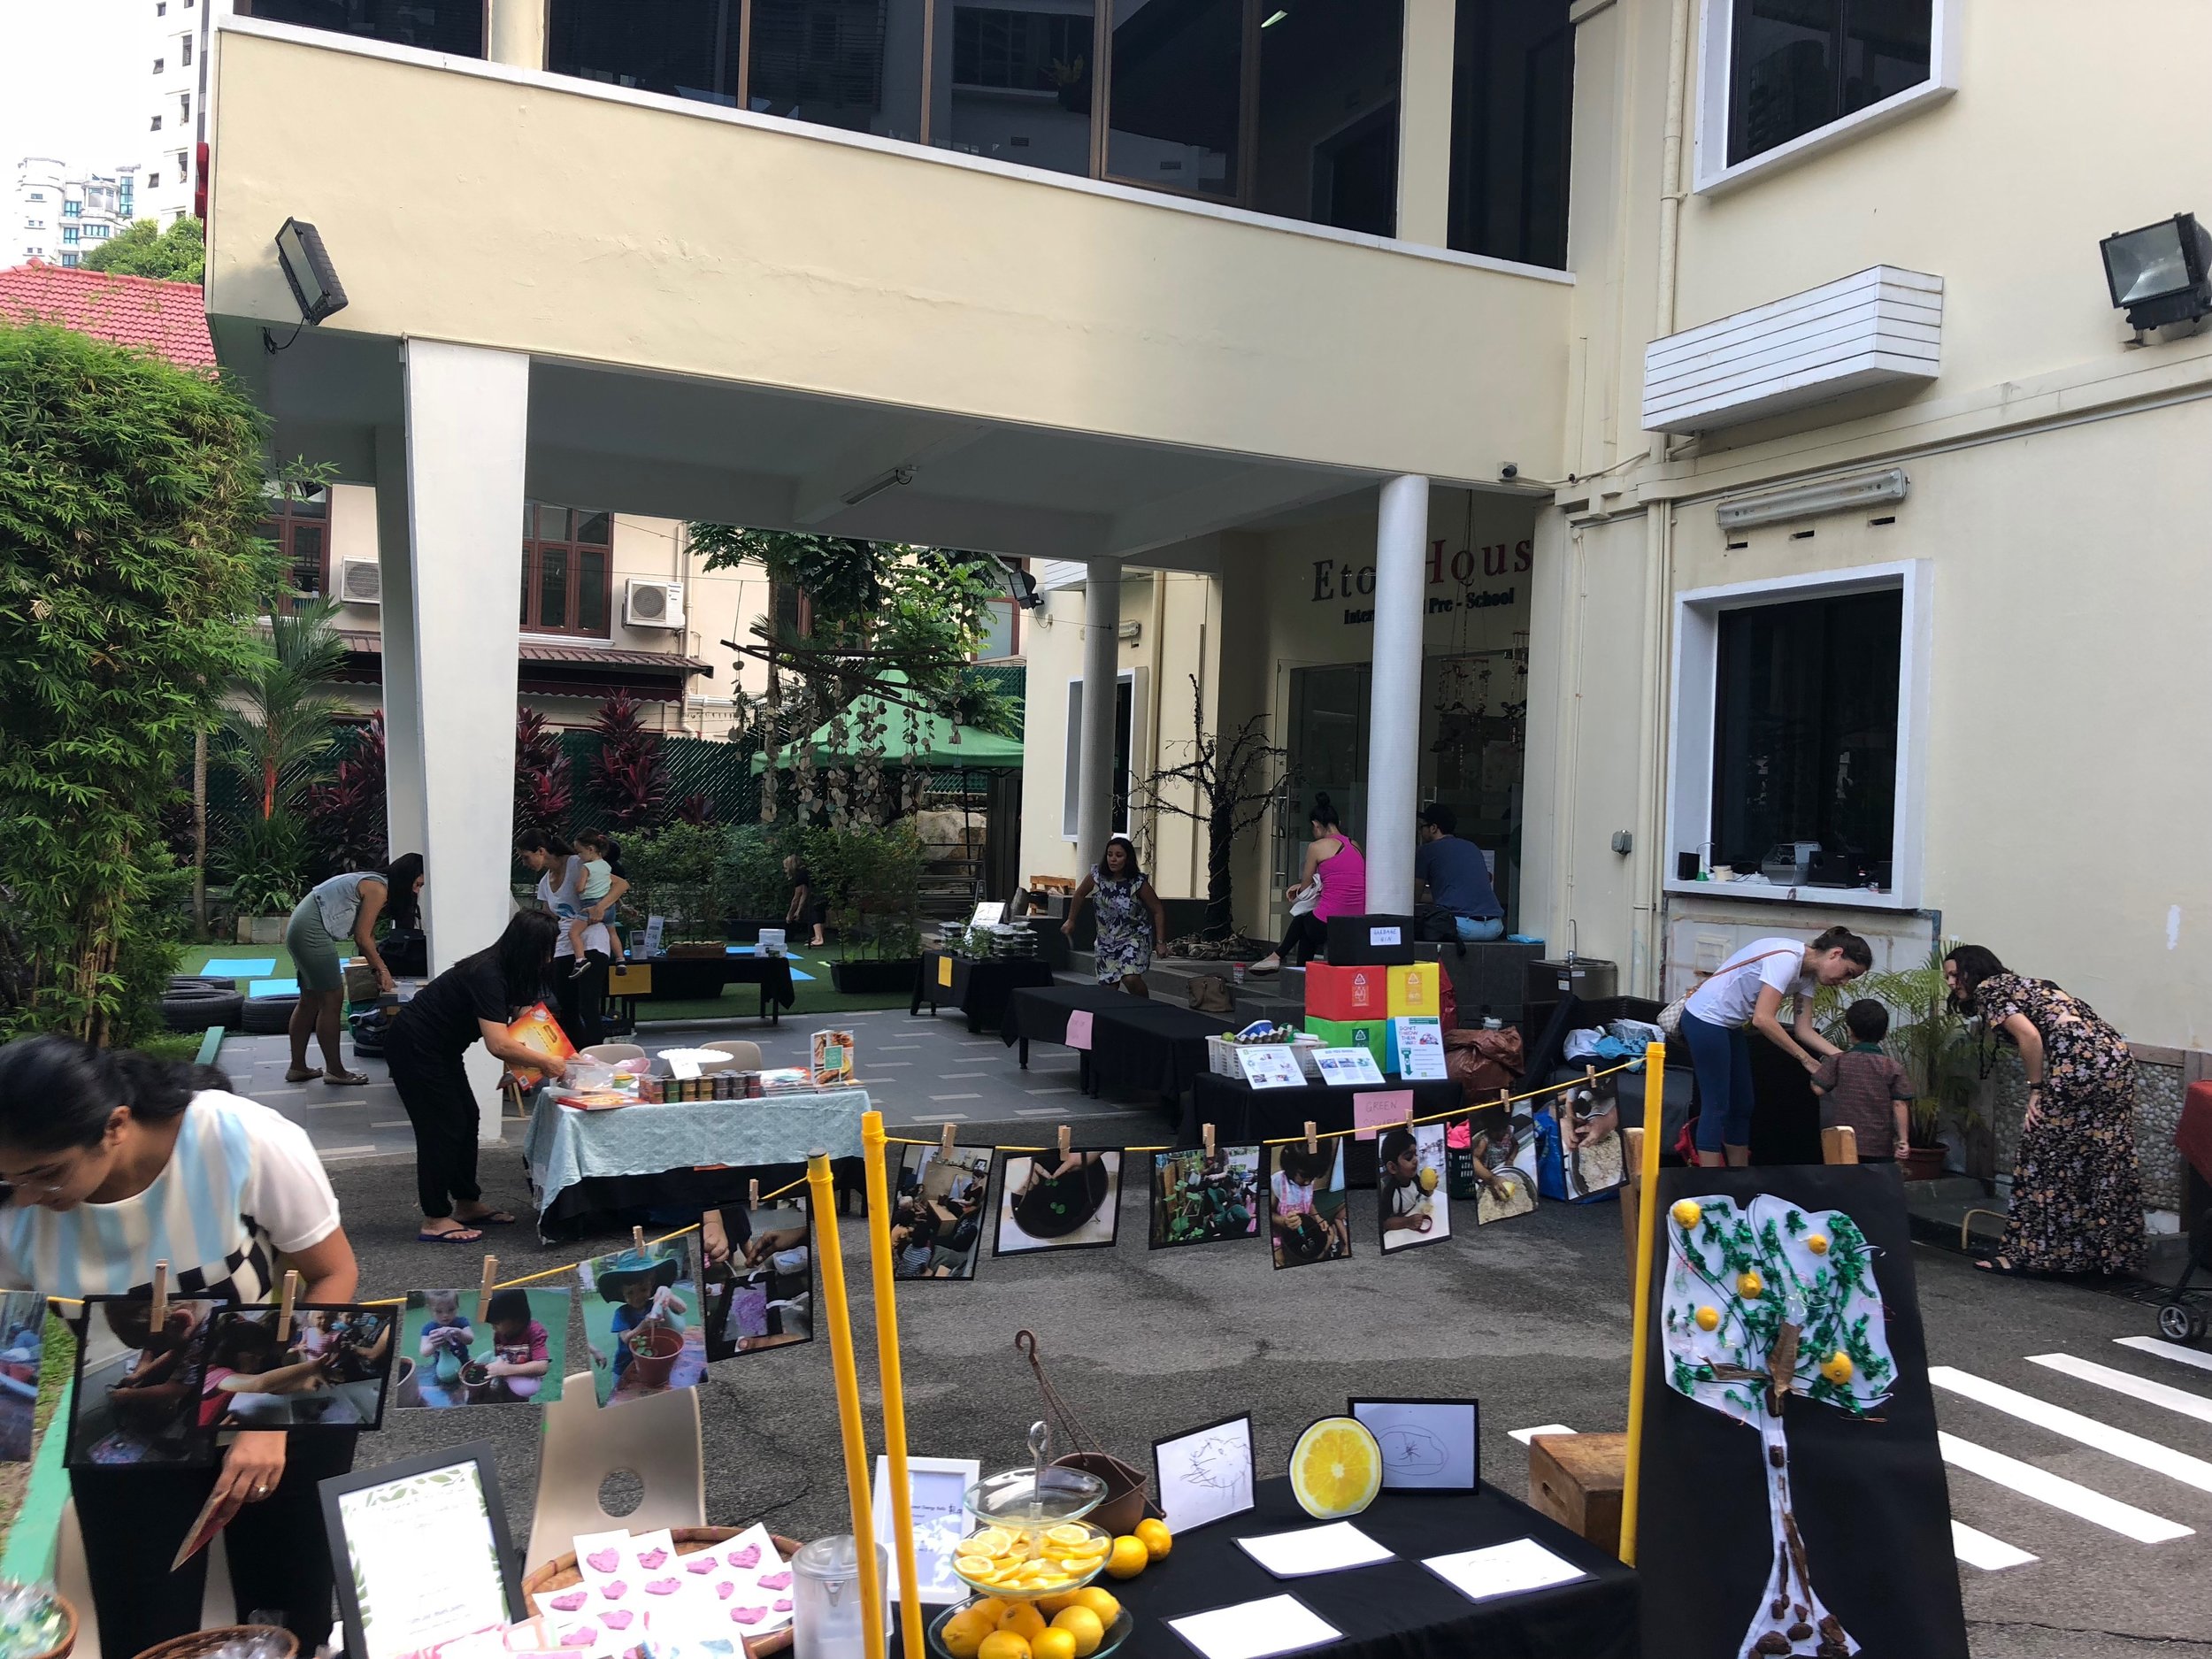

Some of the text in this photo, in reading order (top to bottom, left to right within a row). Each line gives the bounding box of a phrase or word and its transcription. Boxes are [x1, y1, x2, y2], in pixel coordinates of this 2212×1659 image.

[1311, 559, 1377, 602] Eto
[1466, 588, 1515, 609] School
[1365, 1101, 1398, 1112] GREEN
